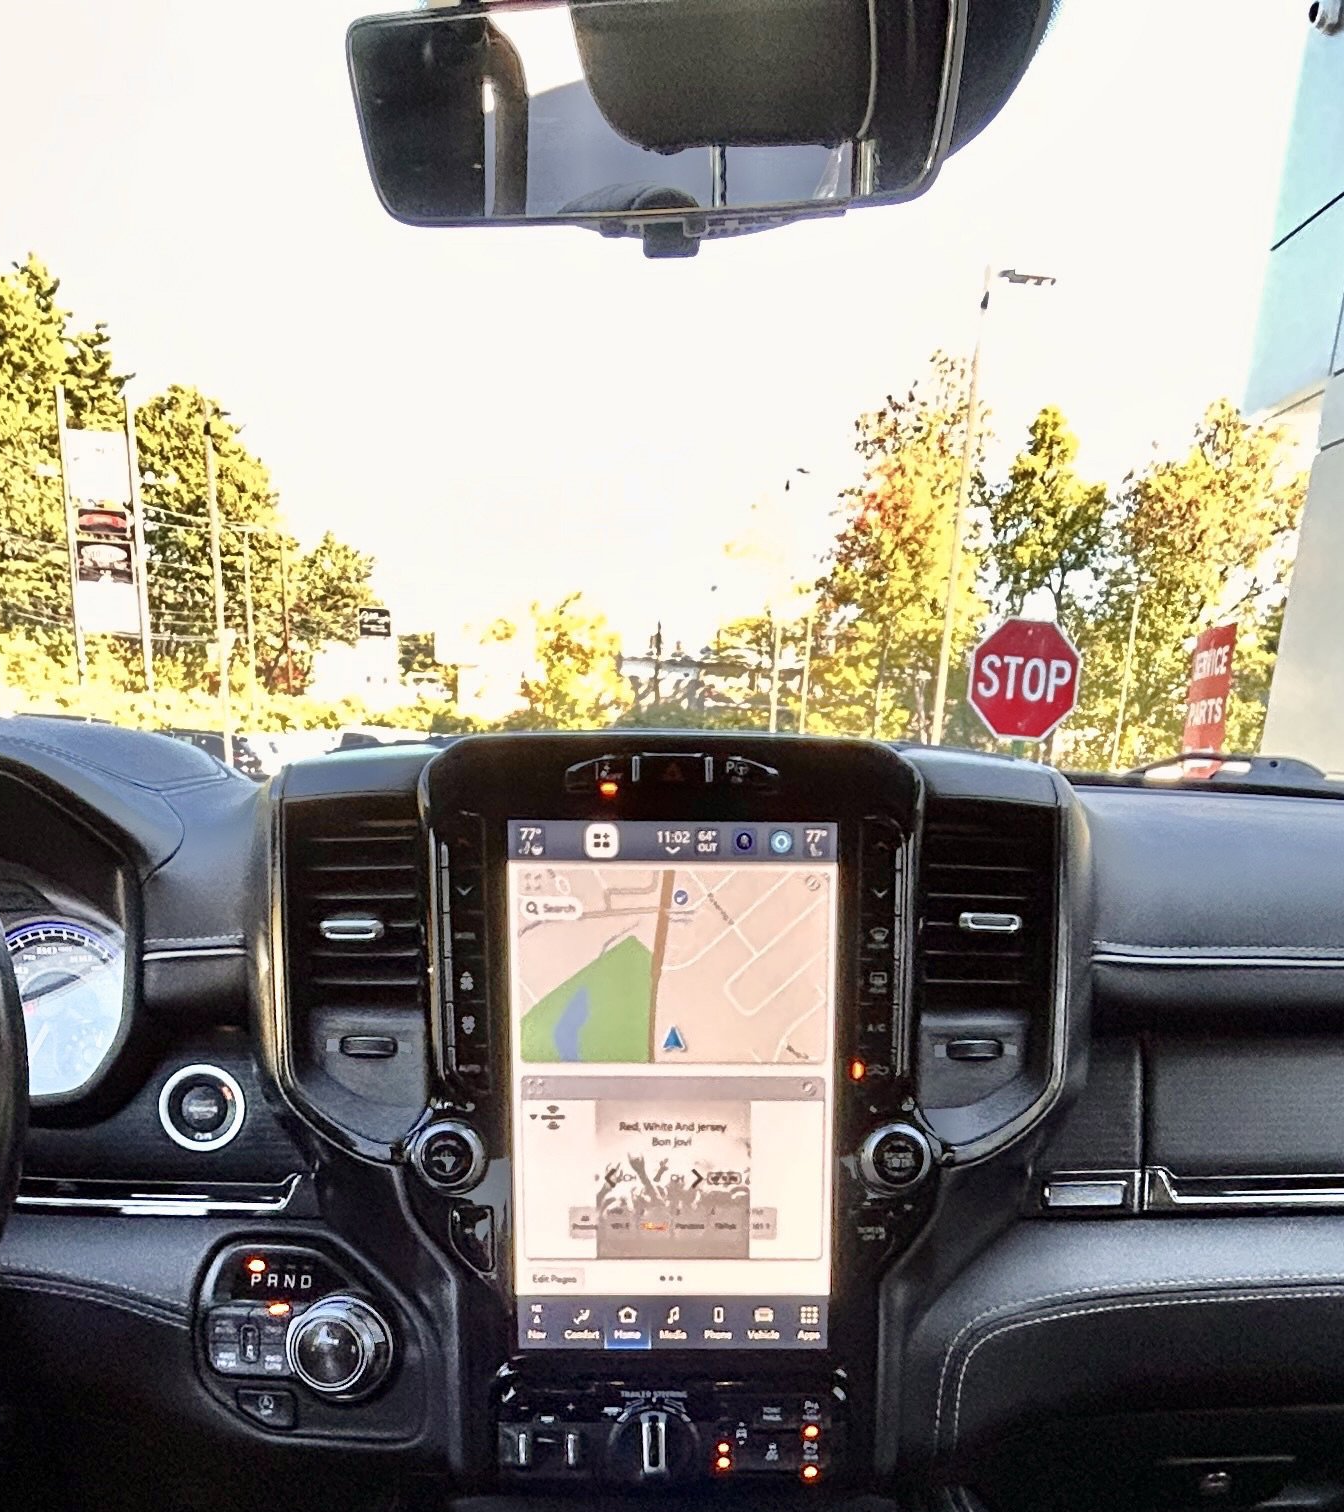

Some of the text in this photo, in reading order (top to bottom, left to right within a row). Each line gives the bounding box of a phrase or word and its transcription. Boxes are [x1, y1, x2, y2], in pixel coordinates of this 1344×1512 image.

[977, 654, 1072, 703] STOP
[657, 831, 691, 844] 11:02
[697, 842, 718, 852] OUT
[543, 903, 577, 914] Search
[619, 1121, 642, 1133] Red,
[643, 1121, 673, 1132] White
[674, 1121, 695, 1132] And
[652, 1136, 671, 1146] Bon
[251, 1273, 312, 1289] P R N D
[532, 1274, 578, 1284] Edit Pages
[527, 1330, 547, 1339] Nav
[564, 1329, 600, 1339] Comfort
[614, 1330, 642, 1339] Home
[659, 1330, 687, 1339] Media
[704, 1330, 733, 1340] Phone
[747, 1330, 780, 1340] Vehicle
[797, 1329, 821, 1341] Apps
